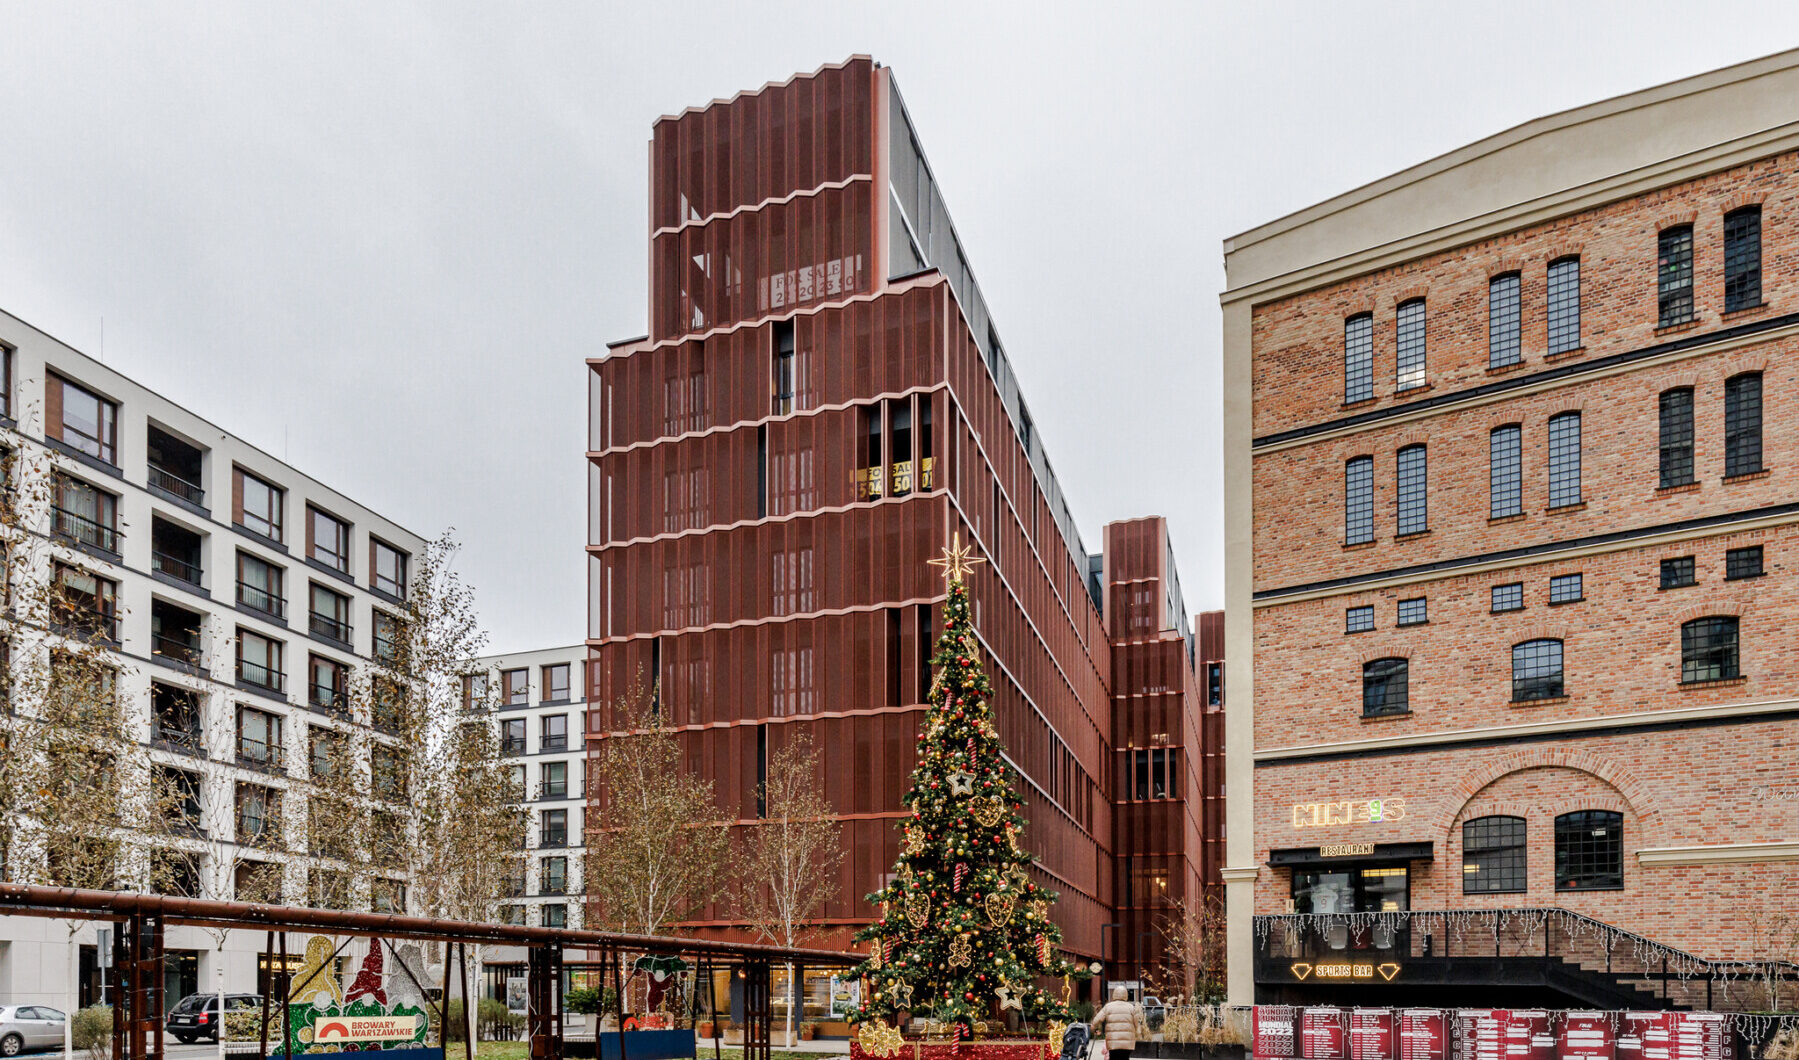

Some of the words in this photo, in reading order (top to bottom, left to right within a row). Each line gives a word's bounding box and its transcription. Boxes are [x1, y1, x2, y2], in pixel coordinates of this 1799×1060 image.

[776, 271, 802, 289] FOR
[807, 263, 841, 281] SALE
[892, 463, 912, 474] SAL
[1320, 843, 1375, 857] RESTAURANT
[1316, 964, 1351, 977] SPORTS
[1353, 964, 1373, 977] BAR
[351, 1021, 396, 1029] BROWARY
[1258, 1021, 1293, 1029] MUNDIAL
[351, 1028, 413, 1037] WARSZAWSKIE
[1723, 1035, 1732, 1045] F
